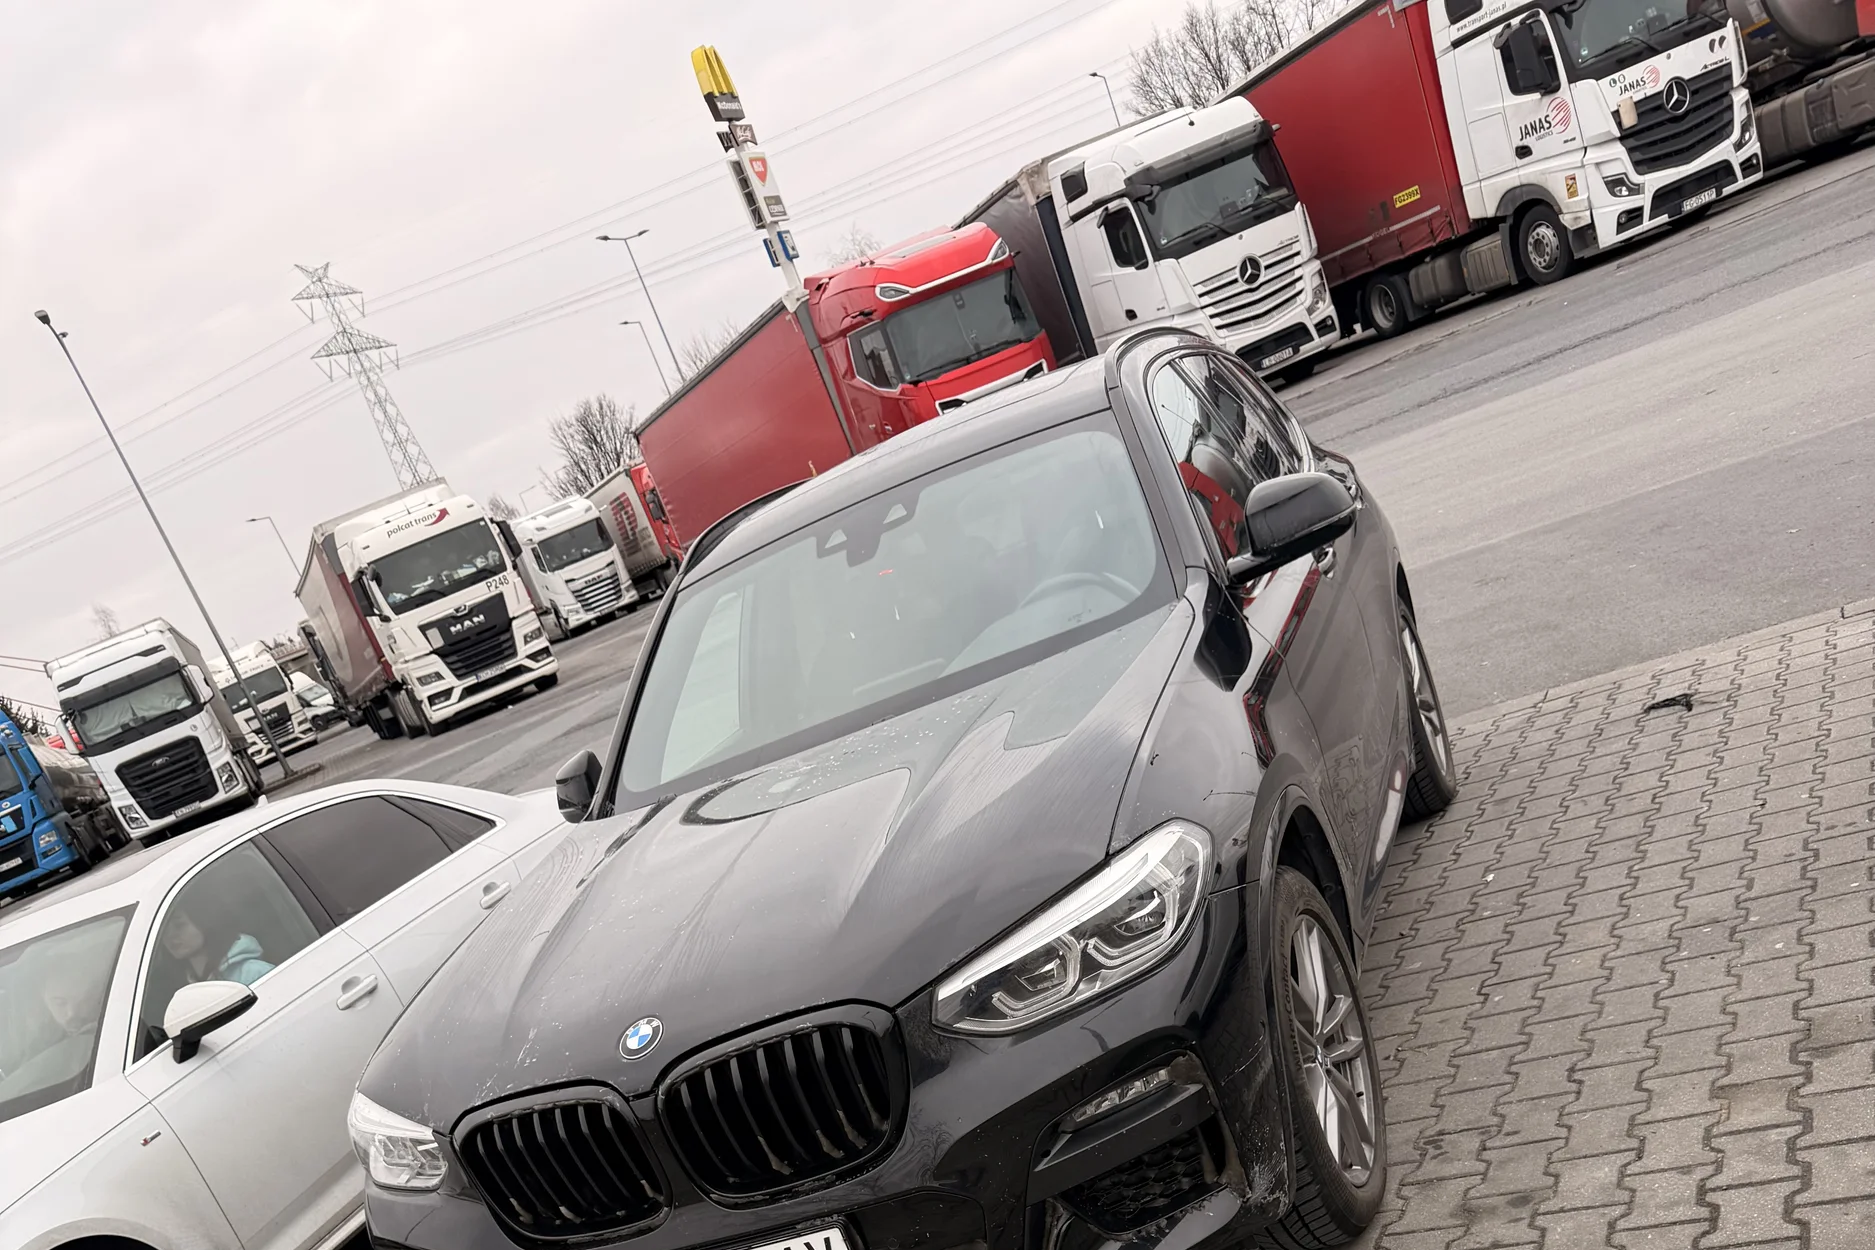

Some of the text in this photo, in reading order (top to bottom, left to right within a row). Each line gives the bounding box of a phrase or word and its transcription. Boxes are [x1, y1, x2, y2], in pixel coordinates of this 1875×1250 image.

[1619, 76, 1647, 96] JANAS
[1519, 114, 1553, 141] JANAS
[1535, 130, 1553, 141] LOGISTICS
[386, 512, 437, 539] polcat trans
[485, 574, 510, 592] P248
[449, 614, 486, 635] MAN
[1281, 955, 1302, 1071] WinterContact
